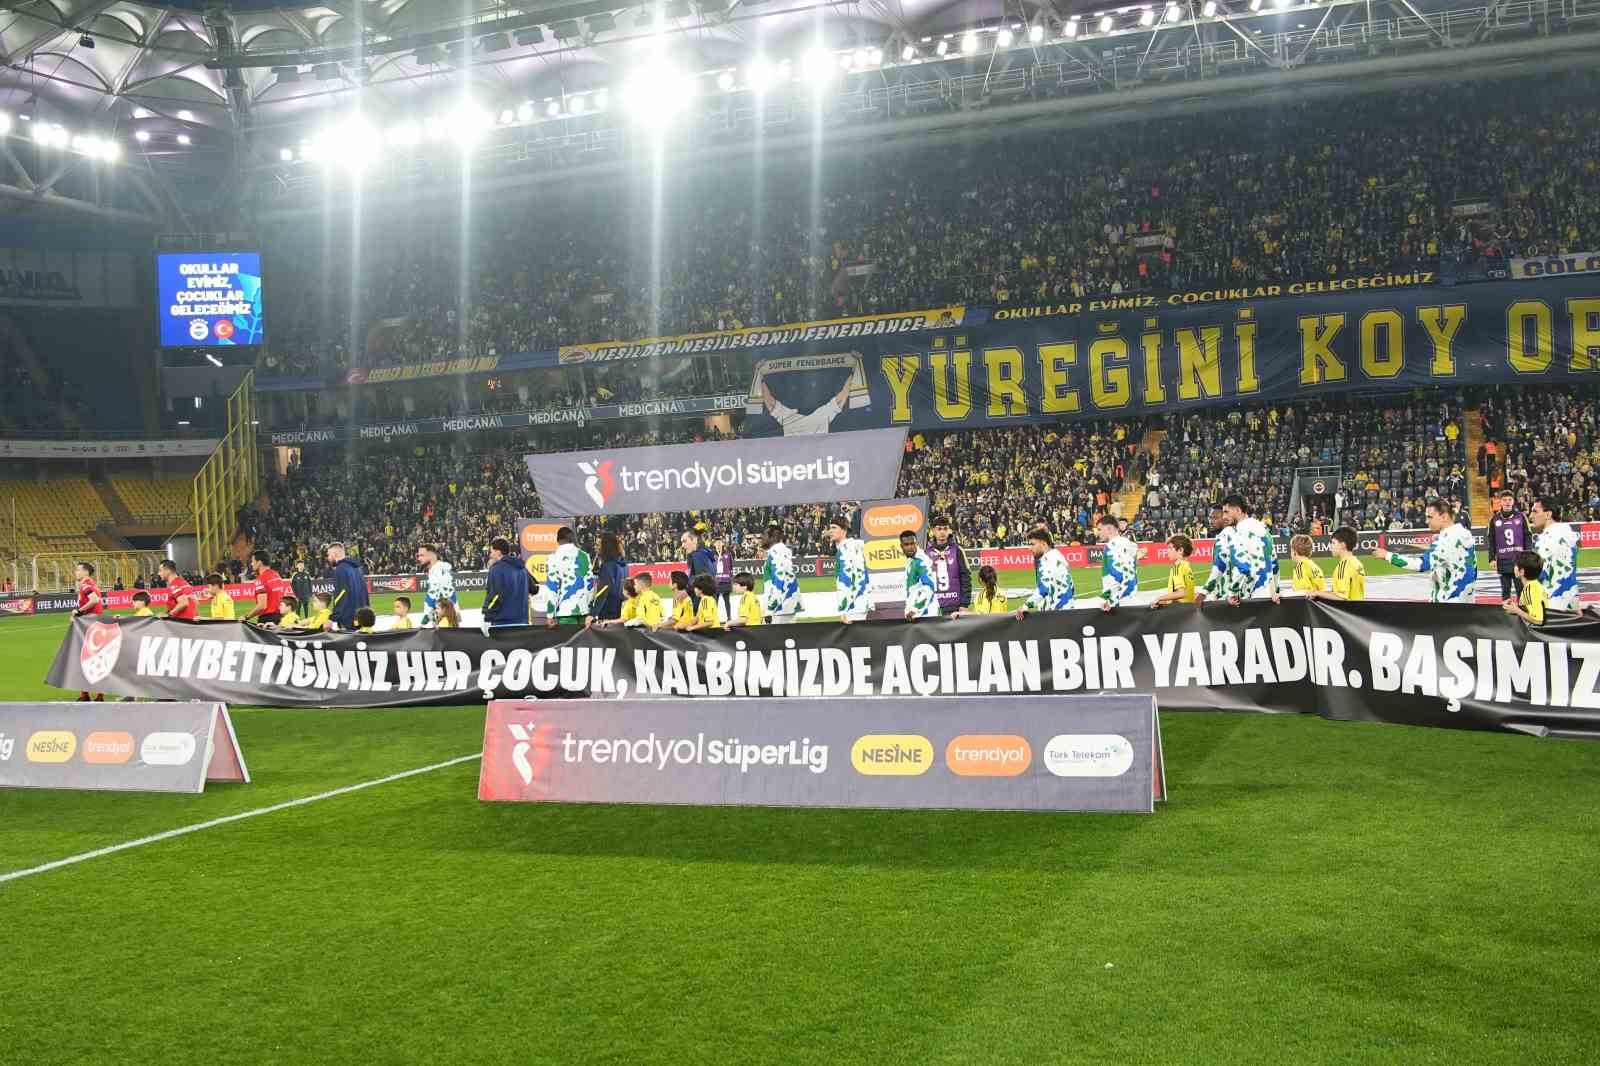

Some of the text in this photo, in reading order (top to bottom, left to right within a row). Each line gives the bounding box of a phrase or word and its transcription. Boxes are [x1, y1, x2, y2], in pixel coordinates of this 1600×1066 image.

[179, 263, 239, 275] OKULLAR
[993, 303, 1083, 320] OKULLAR
[880, 307, 1261, 424] YÜREĞİNİ
[1298, 303, 1468, 385] KOY
[618, 400, 680, 416] MEDICANA
[442, 418, 497, 432] MEDICANA
[528, 409, 585, 425] MEDICANA
[271, 431, 329, 444] MEDICANA
[359, 423, 412, 438] MEDICANA
[619, 458, 743, 493] trendyol
[1504, 528, 1515, 546] 9
[398, 650, 473, 692] HER
[634, 638, 875, 697] KALBİMİZDE
[1050, 625, 1136, 690] BİR
[1142, 626, 1363, 690] YARADIR.
[1368, 631, 1600, 713] BAŞIMIZ
[562, 732, 704, 771] trendyol
[861, 743, 923, 763] NESİNE
[954, 746, 1025, 768] trendyol
